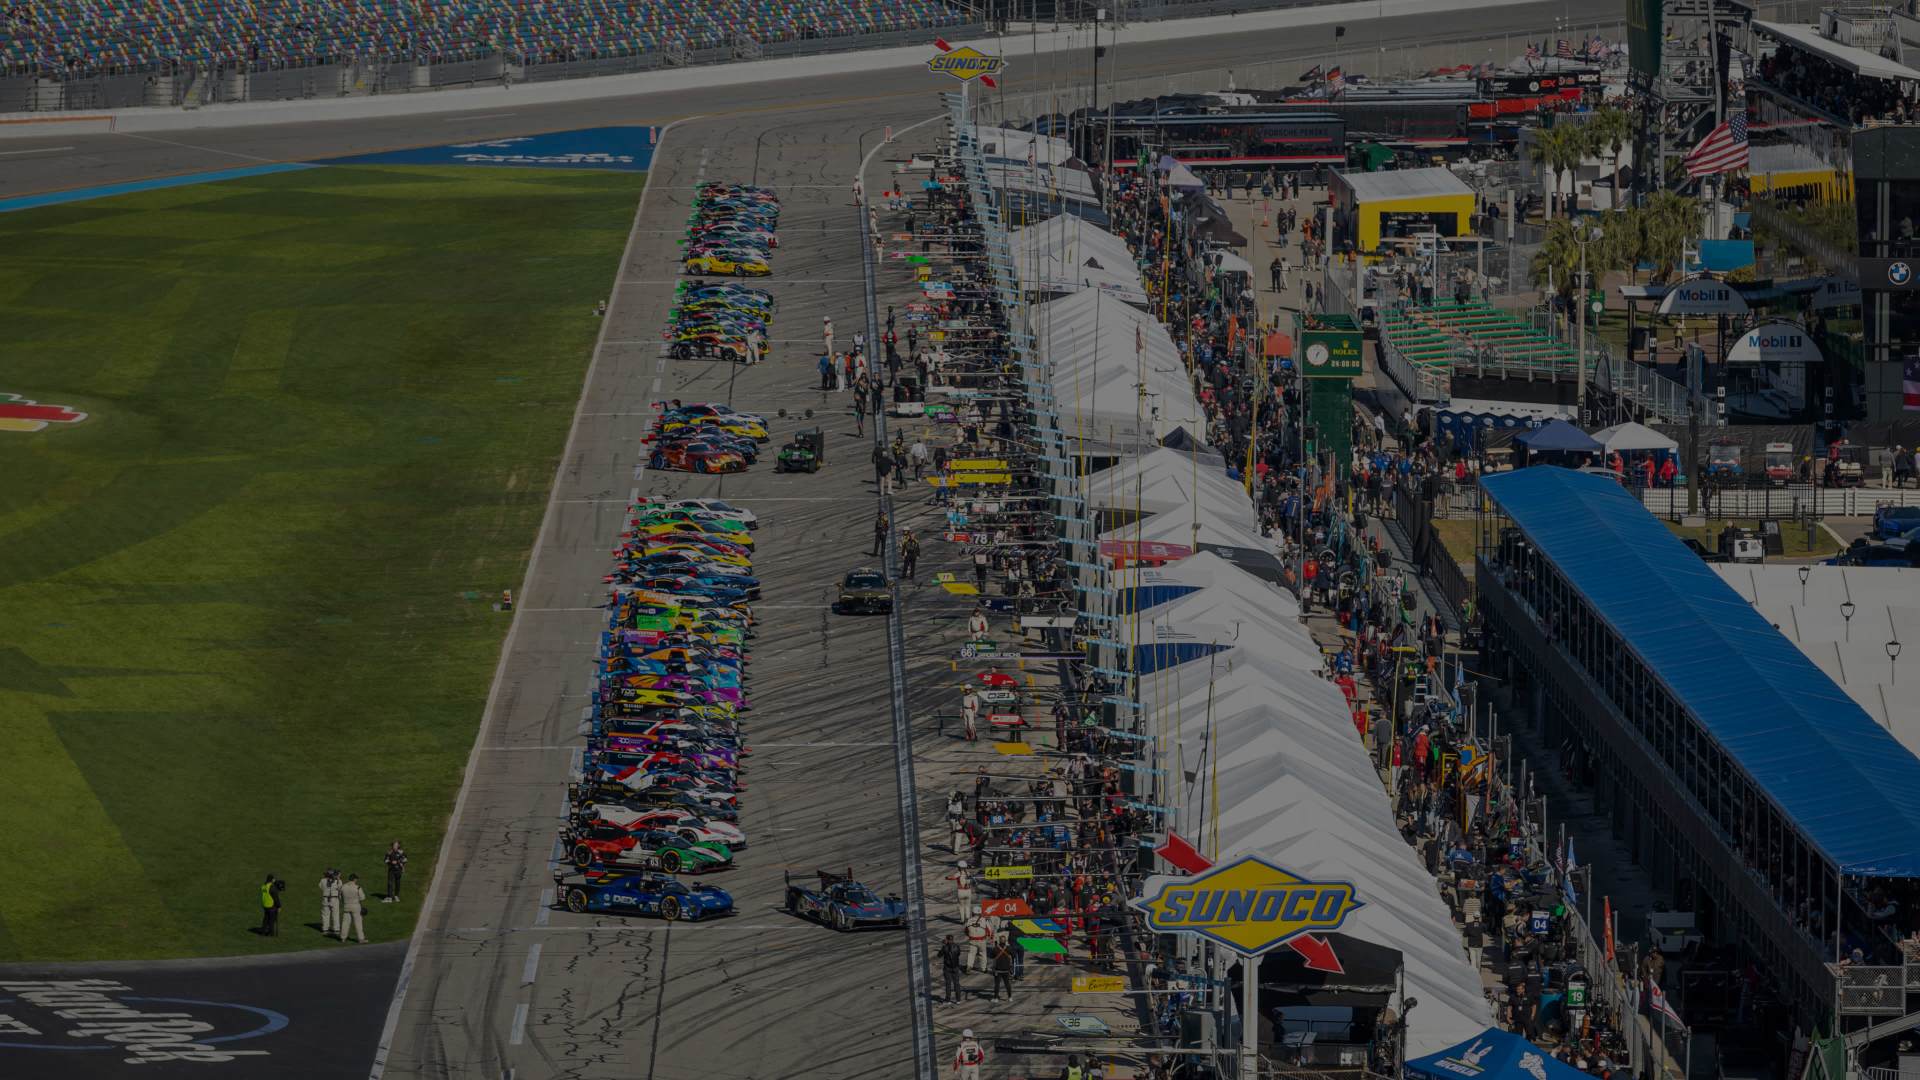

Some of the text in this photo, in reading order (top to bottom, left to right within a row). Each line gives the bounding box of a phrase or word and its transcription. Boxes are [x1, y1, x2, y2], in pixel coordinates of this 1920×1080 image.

[933, 56, 1000, 72] SUNOCO
[1679, 289, 1714, 301] Mobil
[1748, 336, 1786, 347] Mobil
[974, 534, 987, 544] 78
[961, 649, 973, 657] 66
[986, 868, 1000, 877] 44
[613, 894, 637, 904] DEX
[1004, 903, 1016, 912] 04
[1159, 890, 1346, 922] SUNOCO
[1534, 920, 1547, 929] 04
[1571, 991, 1583, 1001] 19
[1069, 1018, 1080, 1027] 36
[67, 1018, 272, 1066] Rock
